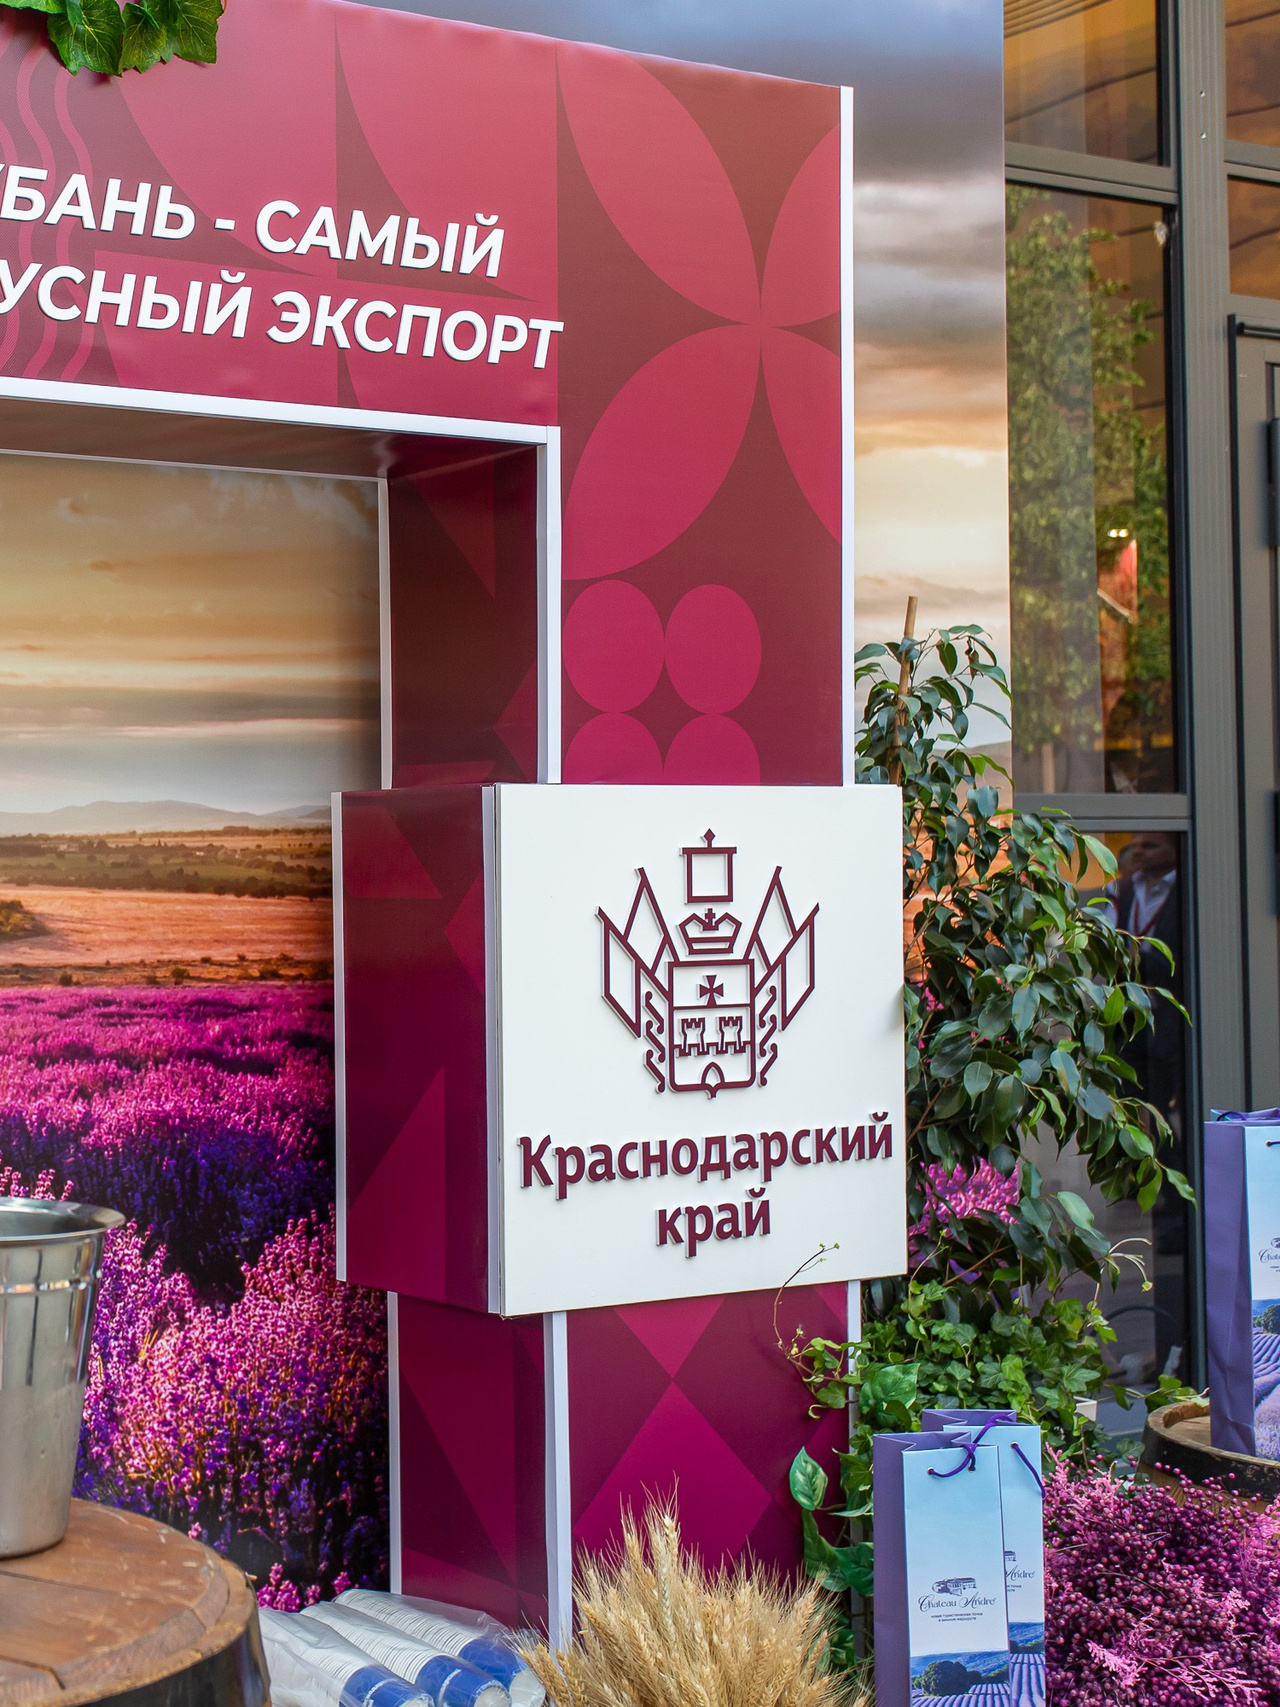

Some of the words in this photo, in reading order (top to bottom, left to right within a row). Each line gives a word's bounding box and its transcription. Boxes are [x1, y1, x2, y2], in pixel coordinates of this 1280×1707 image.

[255, 199, 506, 278] САМЫЙ
[266, 290, 565, 369] ЭКСПОРТ
[517, 1111, 893, 1201] Краснодарский
[656, 1186, 771, 1259] край
